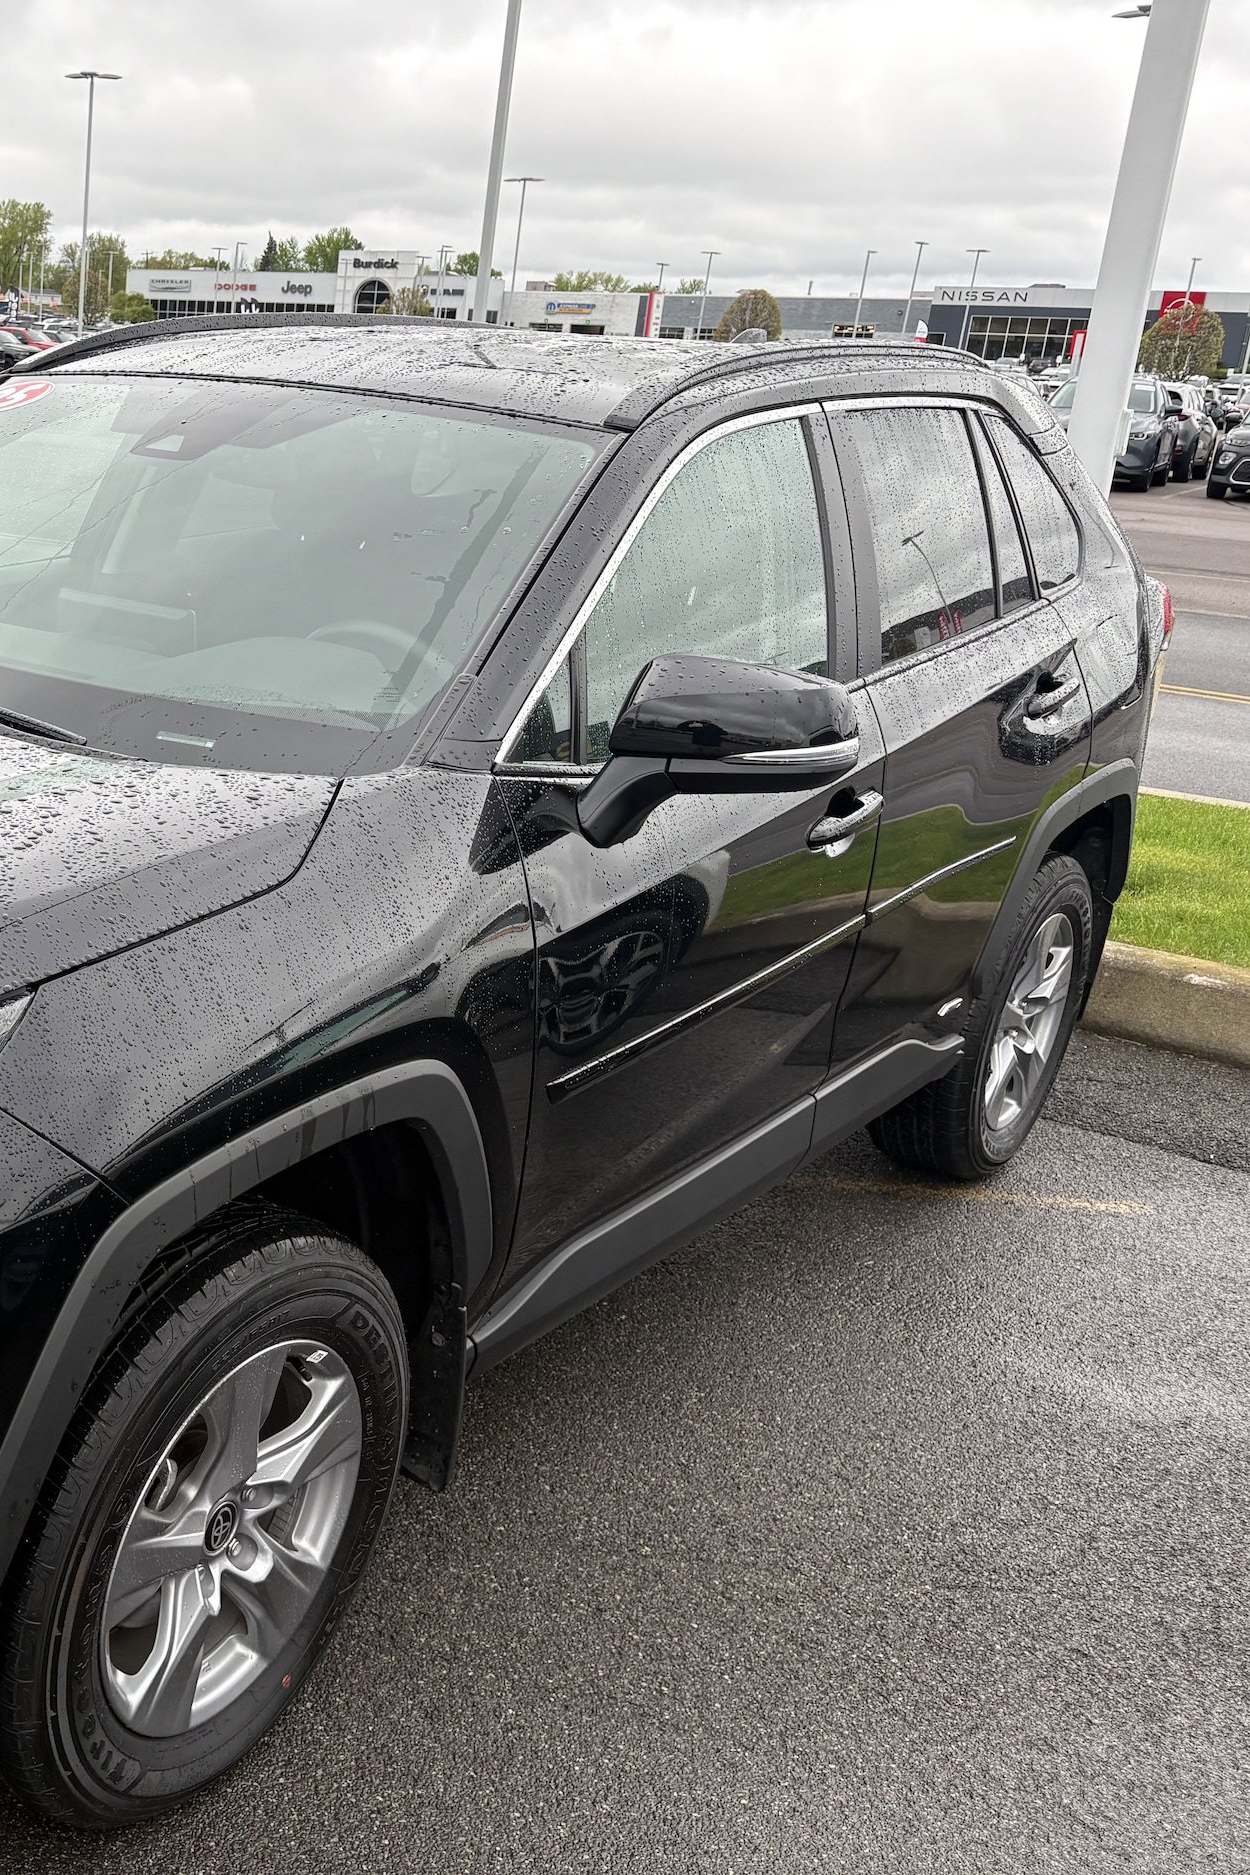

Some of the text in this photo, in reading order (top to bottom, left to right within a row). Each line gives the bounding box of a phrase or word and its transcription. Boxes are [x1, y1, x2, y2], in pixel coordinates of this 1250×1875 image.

[353, 258, 399, 270] Burdick
[214, 283, 256, 292] DODGE
[281, 281, 312, 297] Jeep
[941, 290, 1028, 303] NISSAN
